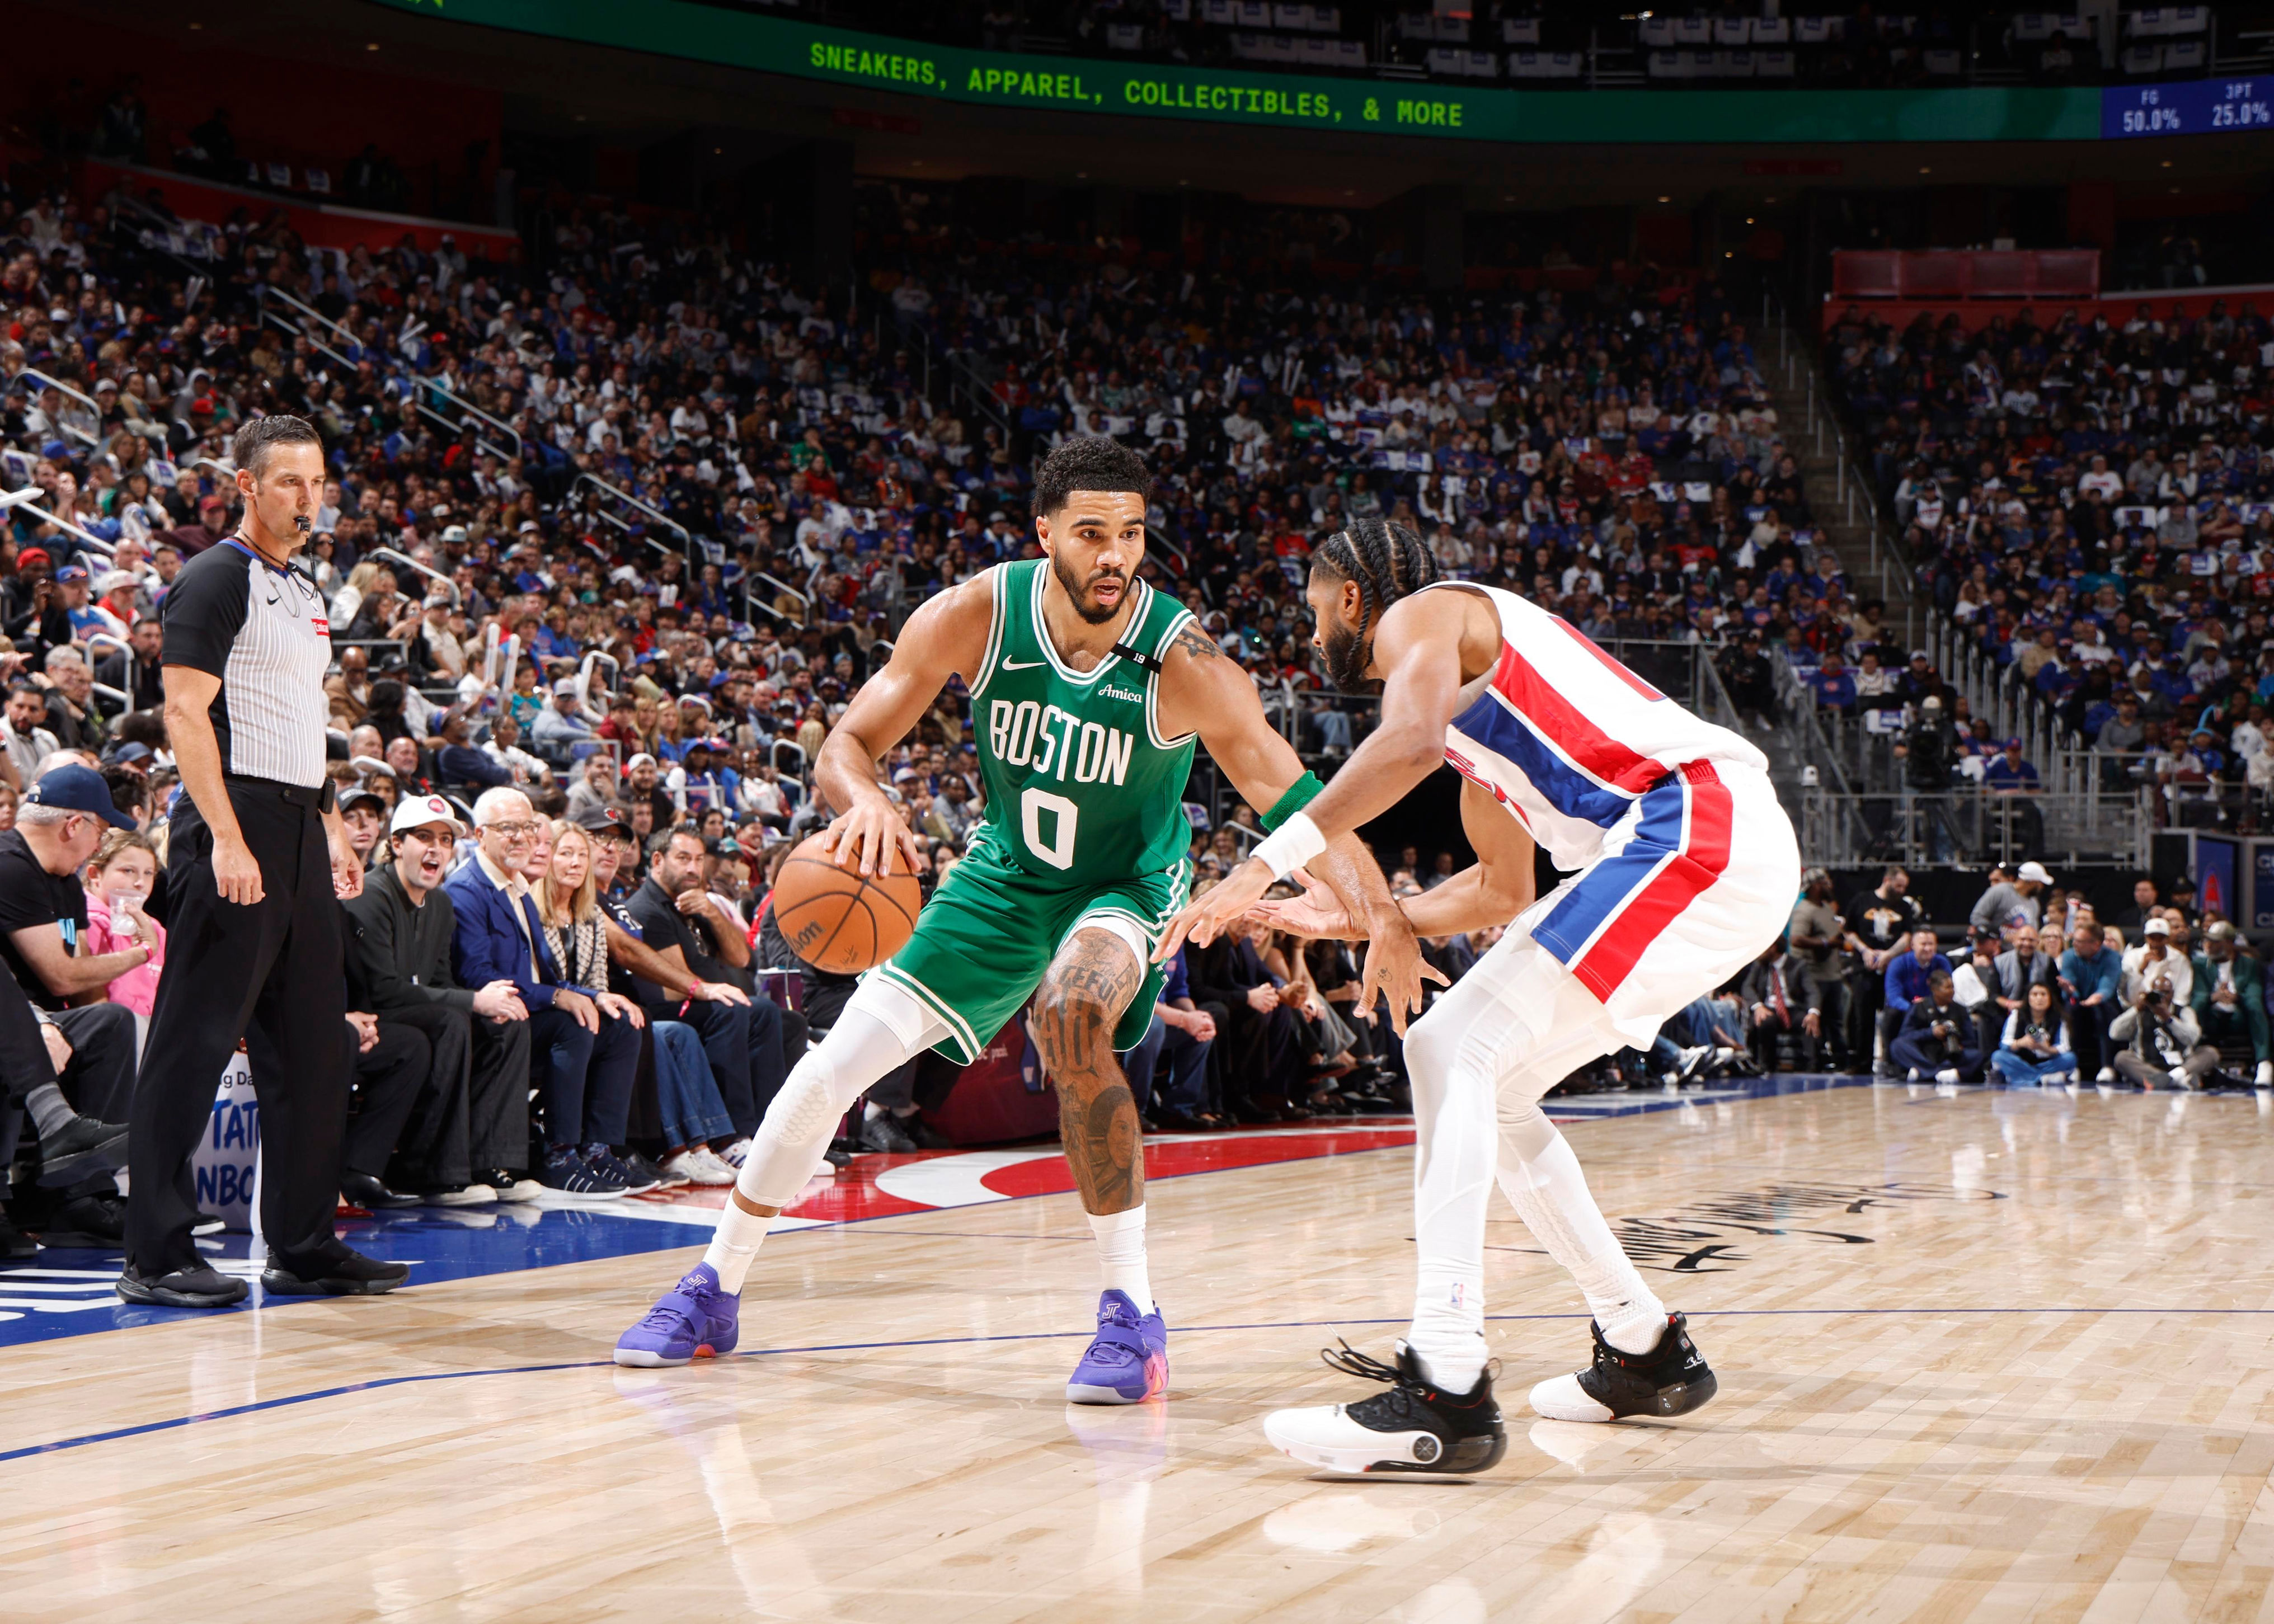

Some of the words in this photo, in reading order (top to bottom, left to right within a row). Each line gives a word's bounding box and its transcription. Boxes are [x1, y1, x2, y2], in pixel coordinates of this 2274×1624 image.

[810, 42, 946, 91] SNEAKERS,
[968, 68, 1102, 105] APPAREL,
[1125, 80, 1342, 122] COLLECTIBLES,
[1364, 97, 1380, 121] &
[1397, 100, 1463, 127] MORE
[2141, 89, 2159, 105] FG
[2225, 82, 2253, 100] 3PT
[2123, 107, 2181, 133] 50.0%
[2212, 101, 2271, 126] 25.0%
[1133, 653, 1145, 664] 19
[1098, 684, 1142, 703] Amica
[990, 699, 1134, 786] BOSTON
[1021, 787, 1078, 870] 0
